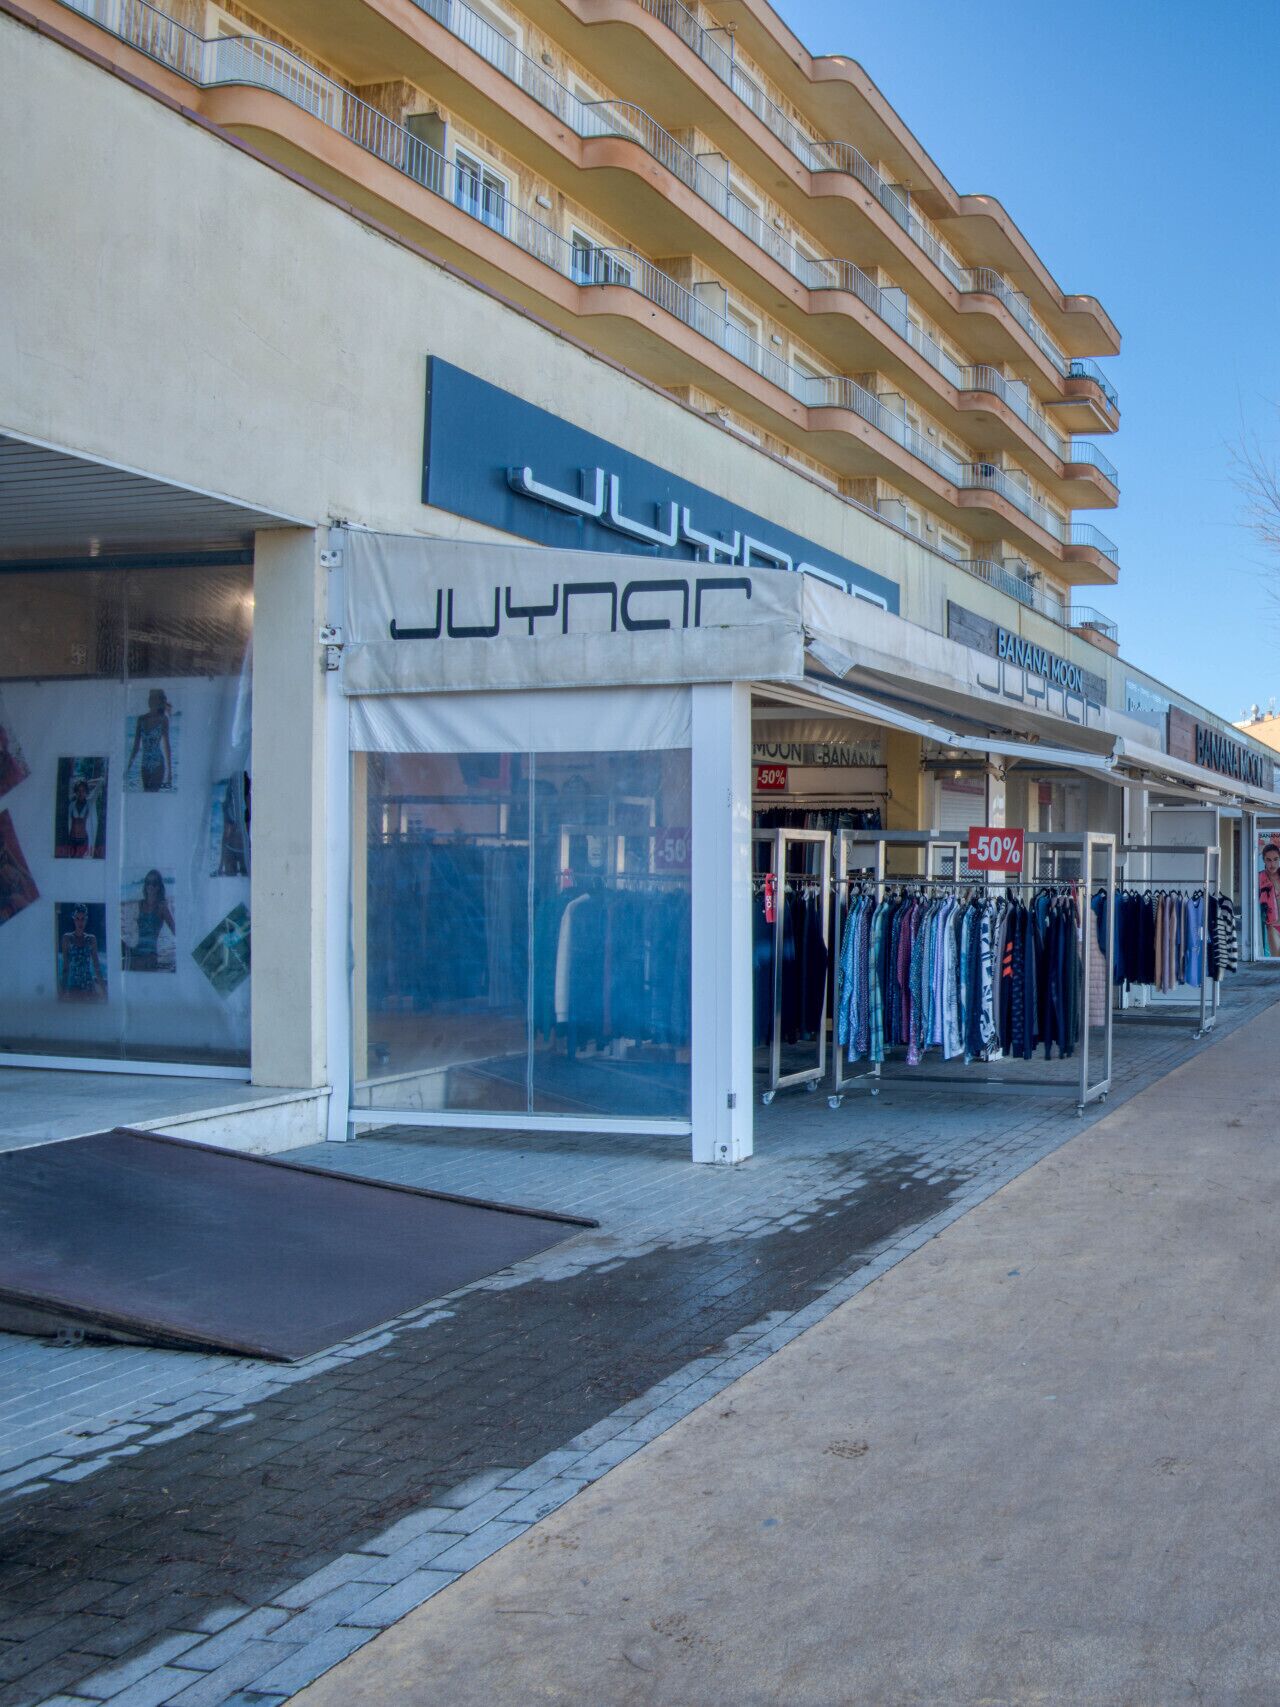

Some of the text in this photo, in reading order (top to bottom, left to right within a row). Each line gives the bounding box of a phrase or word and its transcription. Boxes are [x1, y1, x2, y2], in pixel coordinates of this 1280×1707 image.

[996, 627, 1083, 693] BANANA MOON
[758, 769, 785, 785] -50%
[1195, 724, 1263, 788] BANANA MOON
[970, 836, 1021, 864] -50%
